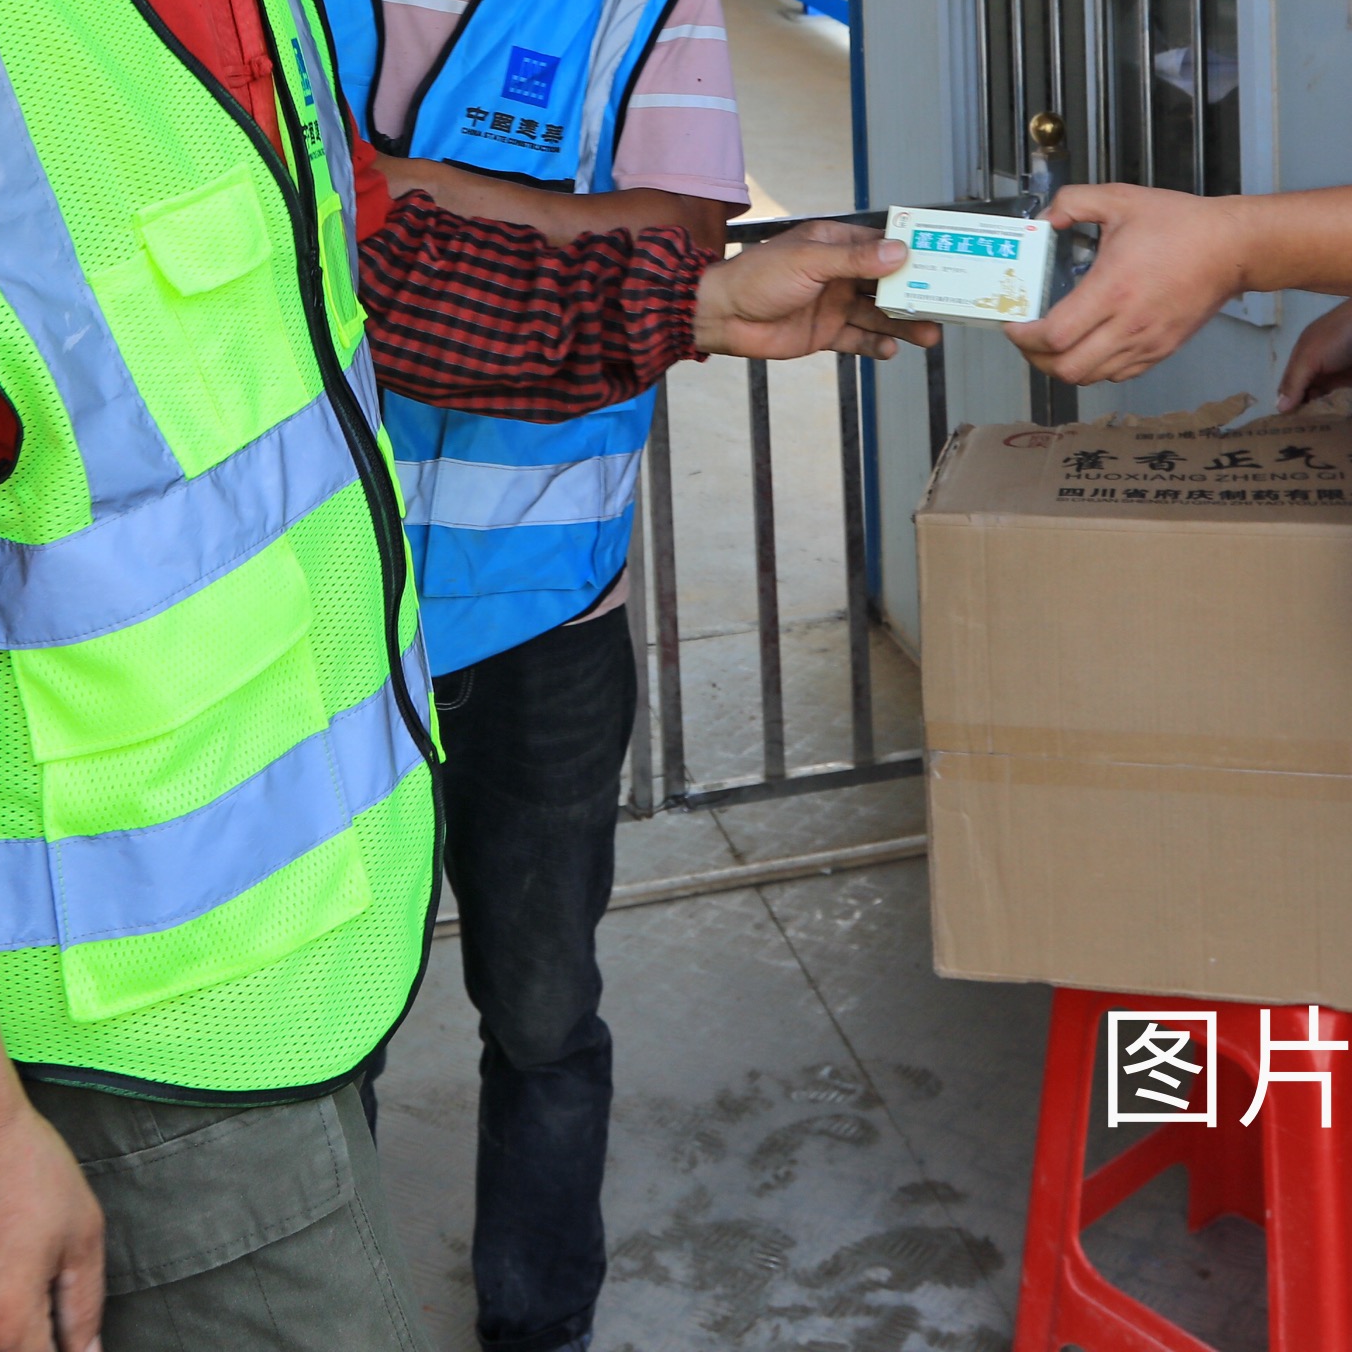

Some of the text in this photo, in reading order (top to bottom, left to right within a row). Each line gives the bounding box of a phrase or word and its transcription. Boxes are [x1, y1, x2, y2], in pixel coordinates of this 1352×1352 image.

[915, 231, 1017, 258] 藿香正气水
[1064, 473, 1208, 482] HUOXIANG
[1215, 472, 1310, 482] ZHENG
